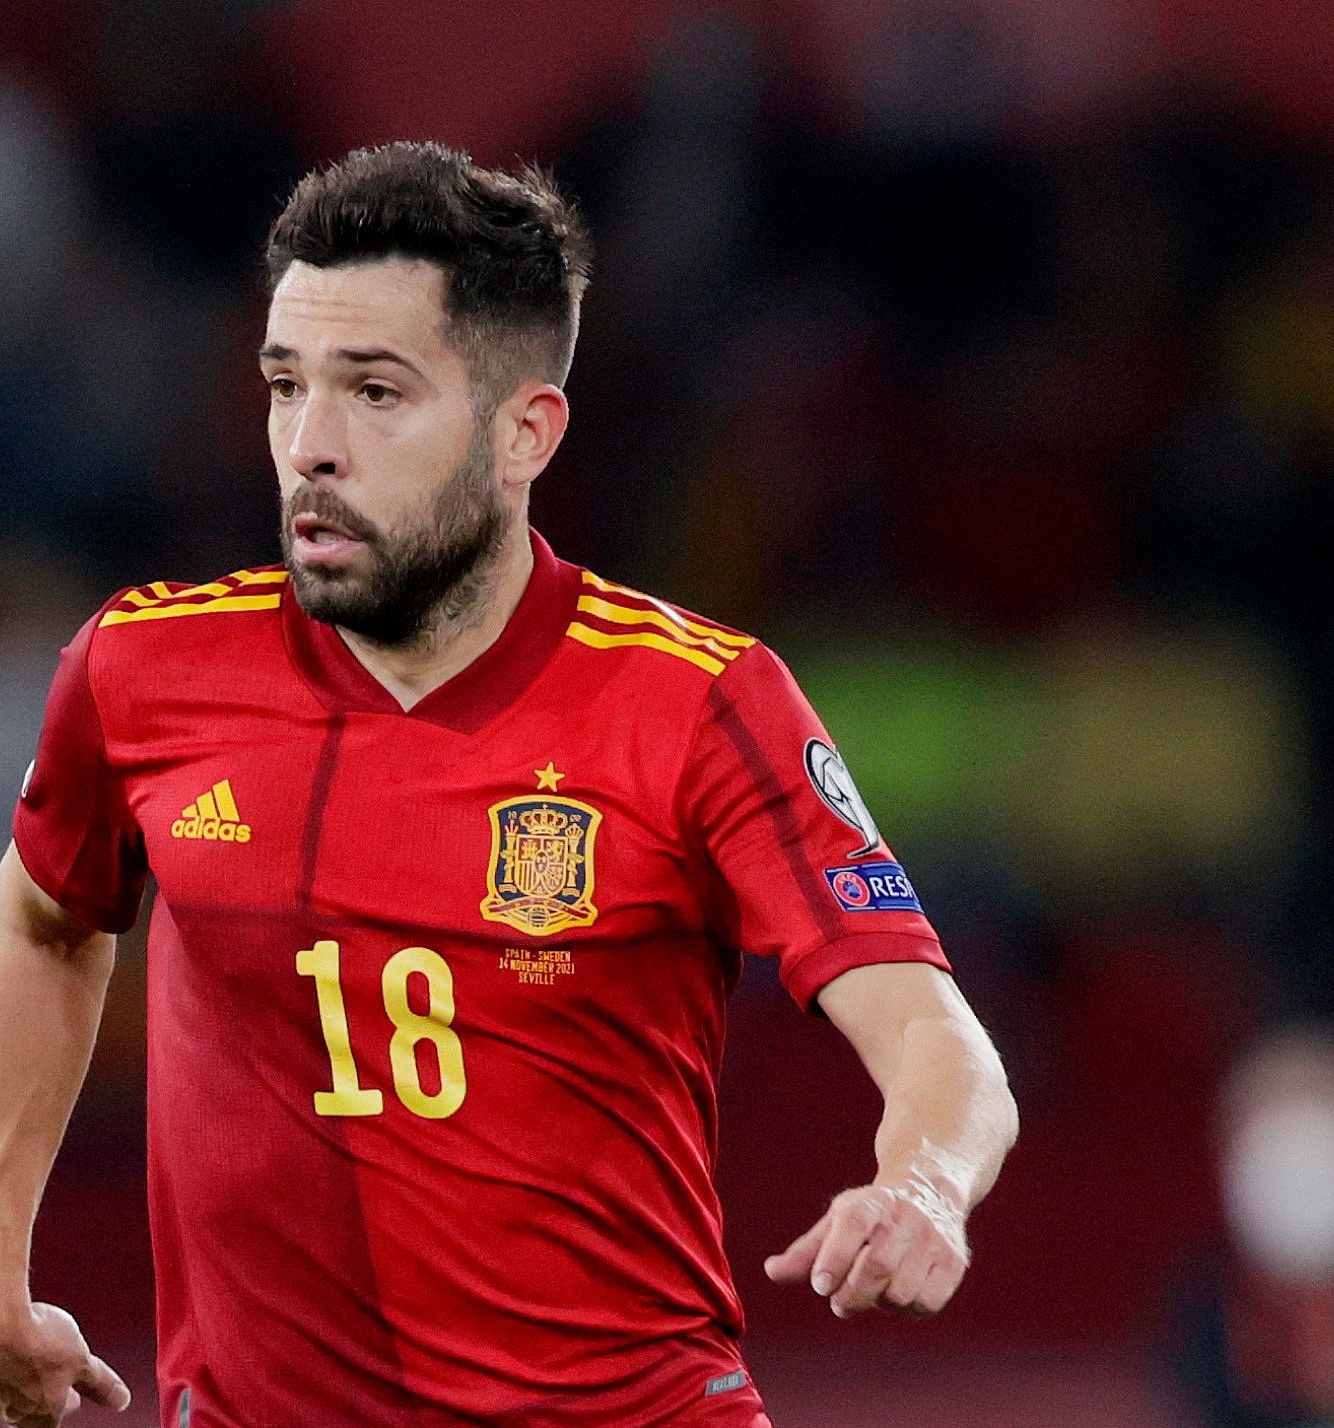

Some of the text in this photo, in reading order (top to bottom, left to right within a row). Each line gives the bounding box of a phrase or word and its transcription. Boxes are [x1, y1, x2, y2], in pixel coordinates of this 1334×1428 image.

[171, 818, 251, 843] adidas
[505, 948, 531, 960] SPAIN
[538, 950, 571, 962] SWEDEN
[511, 960, 554, 972] NOVEMBER
[555, 963, 574, 974] 2021
[519, 972, 555, 984] SEVILLE
[295, 940, 468, 1119] 18
